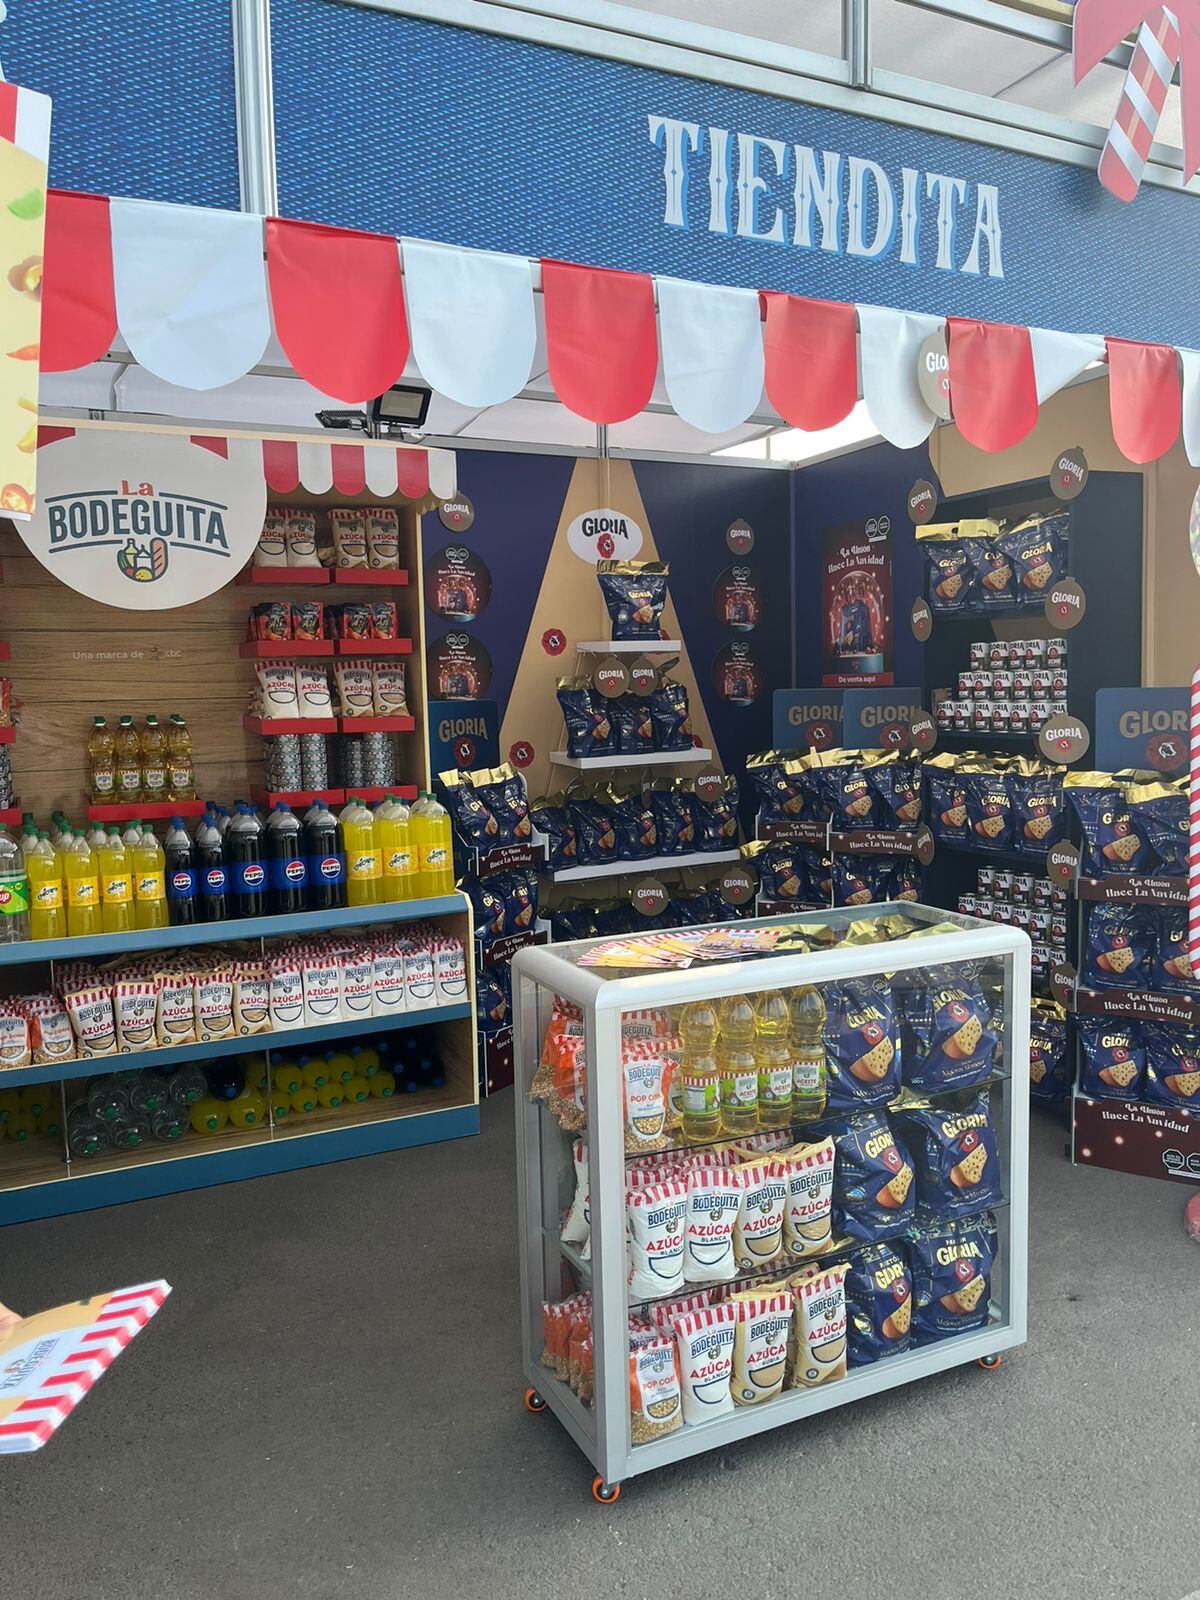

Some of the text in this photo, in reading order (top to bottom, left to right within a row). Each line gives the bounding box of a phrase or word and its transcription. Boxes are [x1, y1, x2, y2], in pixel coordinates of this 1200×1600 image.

[647, 114, 1004, 278] TIENDITA
[926, 352, 948, 373] GLO
[1058, 457, 1084, 482] GLORIA
[121, 480, 154, 496] La
[910, 489, 933, 507] GLORIA
[444, 502, 469, 515] GLORIA
[49, 499, 229, 549] BODEGUITA
[582, 517, 629, 539] GLORIA
[290, 531, 314, 539] AZÚCA
[339, 533, 365, 541] AZÚCA
[730, 529, 751, 539] GLORIA
[1051, 591, 1080, 609] GLORIA
[72, 651, 93, 660] Una
[96, 652, 128, 660] marca
[131, 650, 144, 659] de
[599, 669, 624, 680] GLORIA
[632, 668, 655, 679] GLORIA
[301, 682, 328, 690] AZÚCA
[378, 683, 402, 691] AZÚCA
[860, 705, 921, 728] GLOR
[438, 717, 489, 743] GLORIA
[911, 720, 933, 735] GLORIA
[1119, 710, 1189, 739] GLOR
[1045, 727, 1083, 741] GLORIA
[698, 775, 722, 786] GLORIA
[844, 781, 868, 793] GLORI
[1102, 813, 1132, 825] GLORI
[1051, 853, 1078, 867] GLORIA
[724, 879, 749, 889] GLORIA
[1129, 878, 1142, 887] La
[637, 889, 663, 899] GLORIA
[1135, 888, 1148, 897] La
[1054, 973, 1074, 987] GLORI
[307, 986, 339, 996] AZÚCAR
[1127, 992, 1140, 1001] La
[846, 1006, 887, 1029] GORIA
[1133, 1001, 1146, 1011] La
[1148, 1003, 1193, 1020] Navidad
[622, 1027, 653, 1036] DEGUITA
[1030, 1038, 1052, 1052] LORIA
[1101, 1036, 1130, 1048] GLOR
[628, 1068, 661, 1080] BODEGUIT
[630, 1094, 647, 1103] POP
[1125, 1103, 1138, 1113] La
[941, 1114, 989, 1139] GLORIA
[1102, 1111, 1190, 1134] Hace La Navidad
[865, 1131, 895, 1159] GLOR
[790, 1171, 833, 1193] BODEGUITA
[692, 1195, 739, 1209] BODEGUITA
[746, 1186, 786, 1208] BODEGUITA
[648, 1204, 687, 1226] BODEGUIT
[743, 1212, 783, 1232] AZÚCA
[646, 1235, 683, 1251] AZÚC
[701, 1235, 727, 1243] BLANCA
[660, 1246, 683, 1256] BLANC
[936, 1241, 984, 1266] GLORIA
[875, 1261, 905, 1290] GLOR
[751, 1320, 788, 1339] BODEGUIT
[691, 1331, 734, 1357] BODEGUITA
[747, 1344, 785, 1364] AZÚCA
[690, 1359, 731, 1379] AZÚCA
[660, 1376, 675, 1385] COR
[704, 1370, 728, 1383] BLANCA
